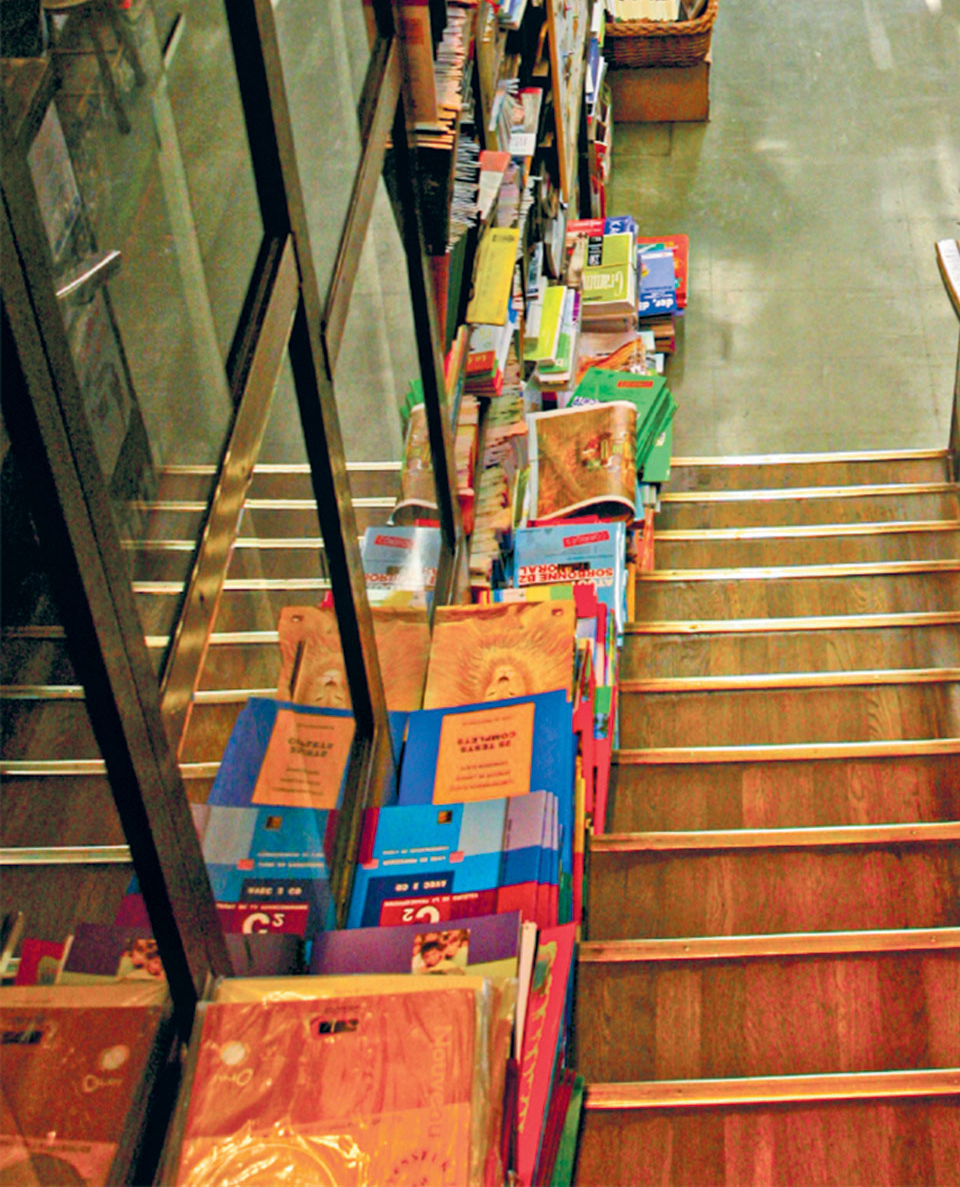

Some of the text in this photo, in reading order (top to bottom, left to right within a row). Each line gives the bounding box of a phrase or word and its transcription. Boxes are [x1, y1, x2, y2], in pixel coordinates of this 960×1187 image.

[518, 564, 558, 575] ORAL
[518, 566, 614, 584] SORBONNE B2
[427, 1025, 454, 1139] Nouveau
